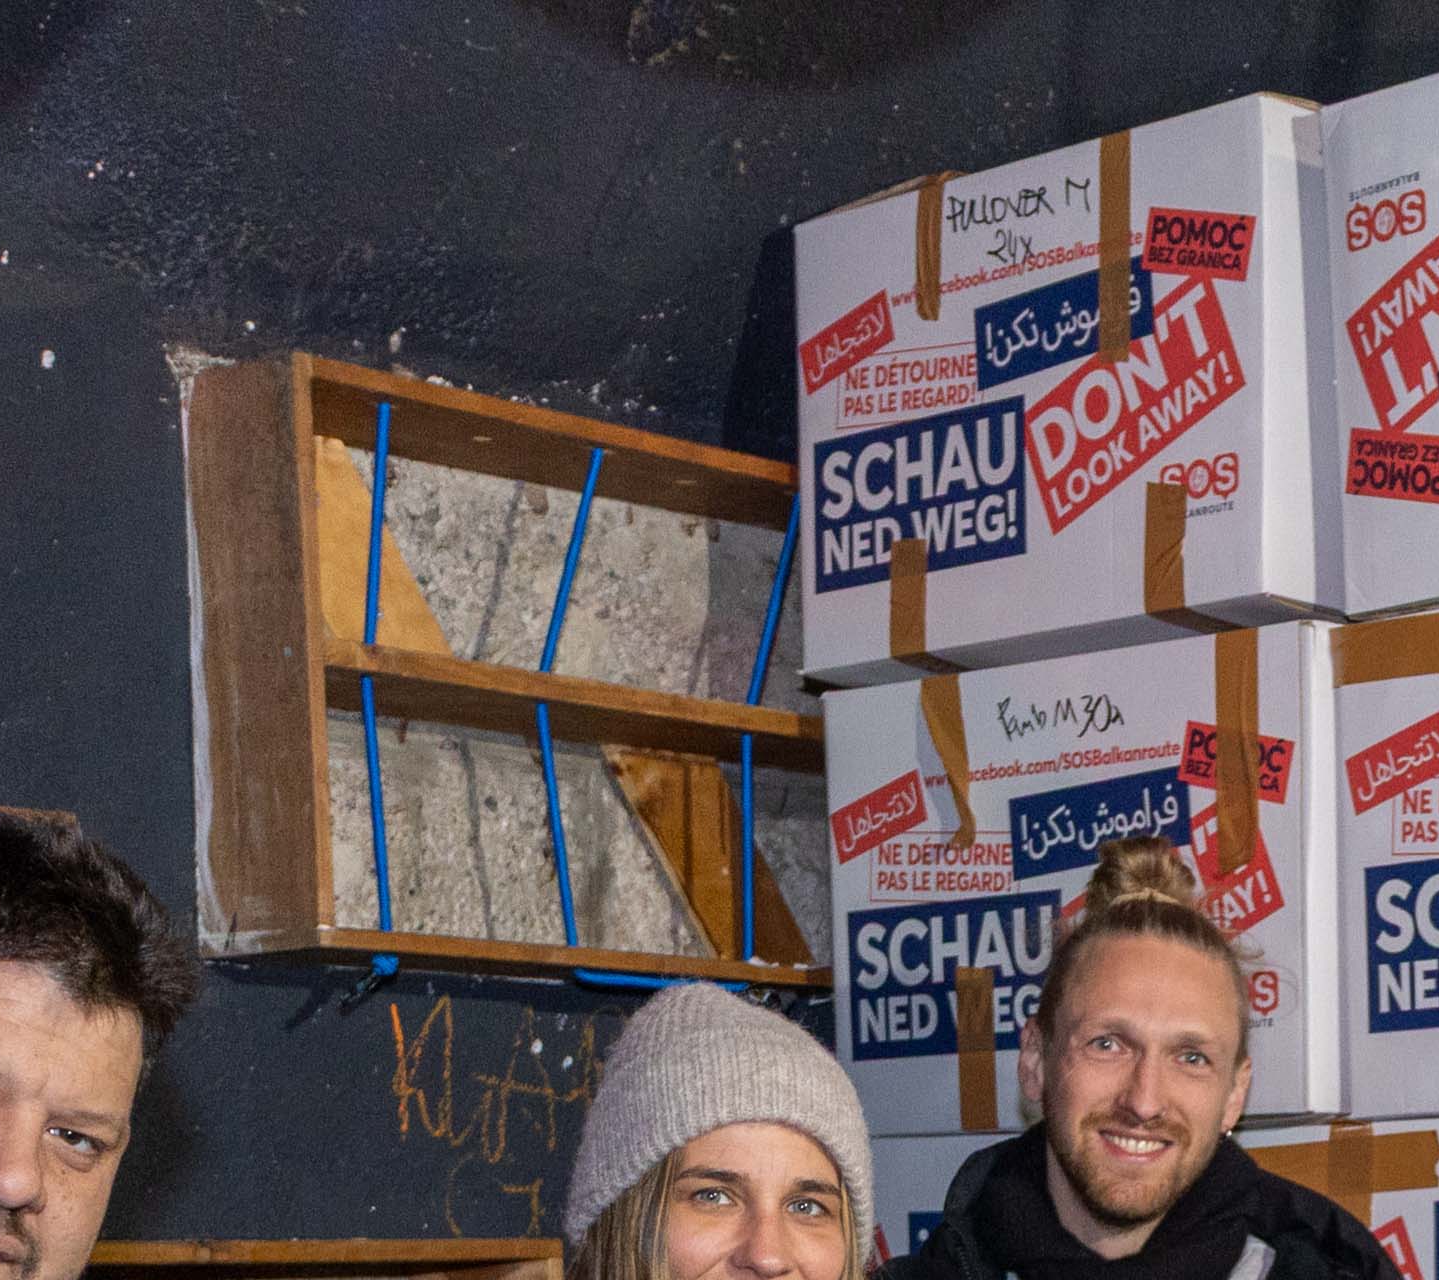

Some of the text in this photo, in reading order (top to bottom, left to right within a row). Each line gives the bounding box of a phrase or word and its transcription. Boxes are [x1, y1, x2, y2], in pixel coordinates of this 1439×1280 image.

[1150, 216, 1246, 250] POMOĆ
[1347, 189, 1425, 251] SOS
[1150, 248, 1241, 271] BEZ GRANICA
[846, 353, 976, 390] NE DÉTOURNE
[844, 382, 976, 416] PAS LE REGARD!
[1051, 356, 1230, 518] LOOK AWAY!
[822, 413, 1015, 519] SCHAU
[823, 499, 1017, 574] NED WEG!
[1054, 698, 1077, 727] M
[1402, 789, 1434, 814] NE
[879, 845, 902, 865] NE
[878, 870, 1012, 893] PAS LE REGARD!
[858, 905, 1054, 989] SCHAU
[859, 996, 938, 1043] NED
